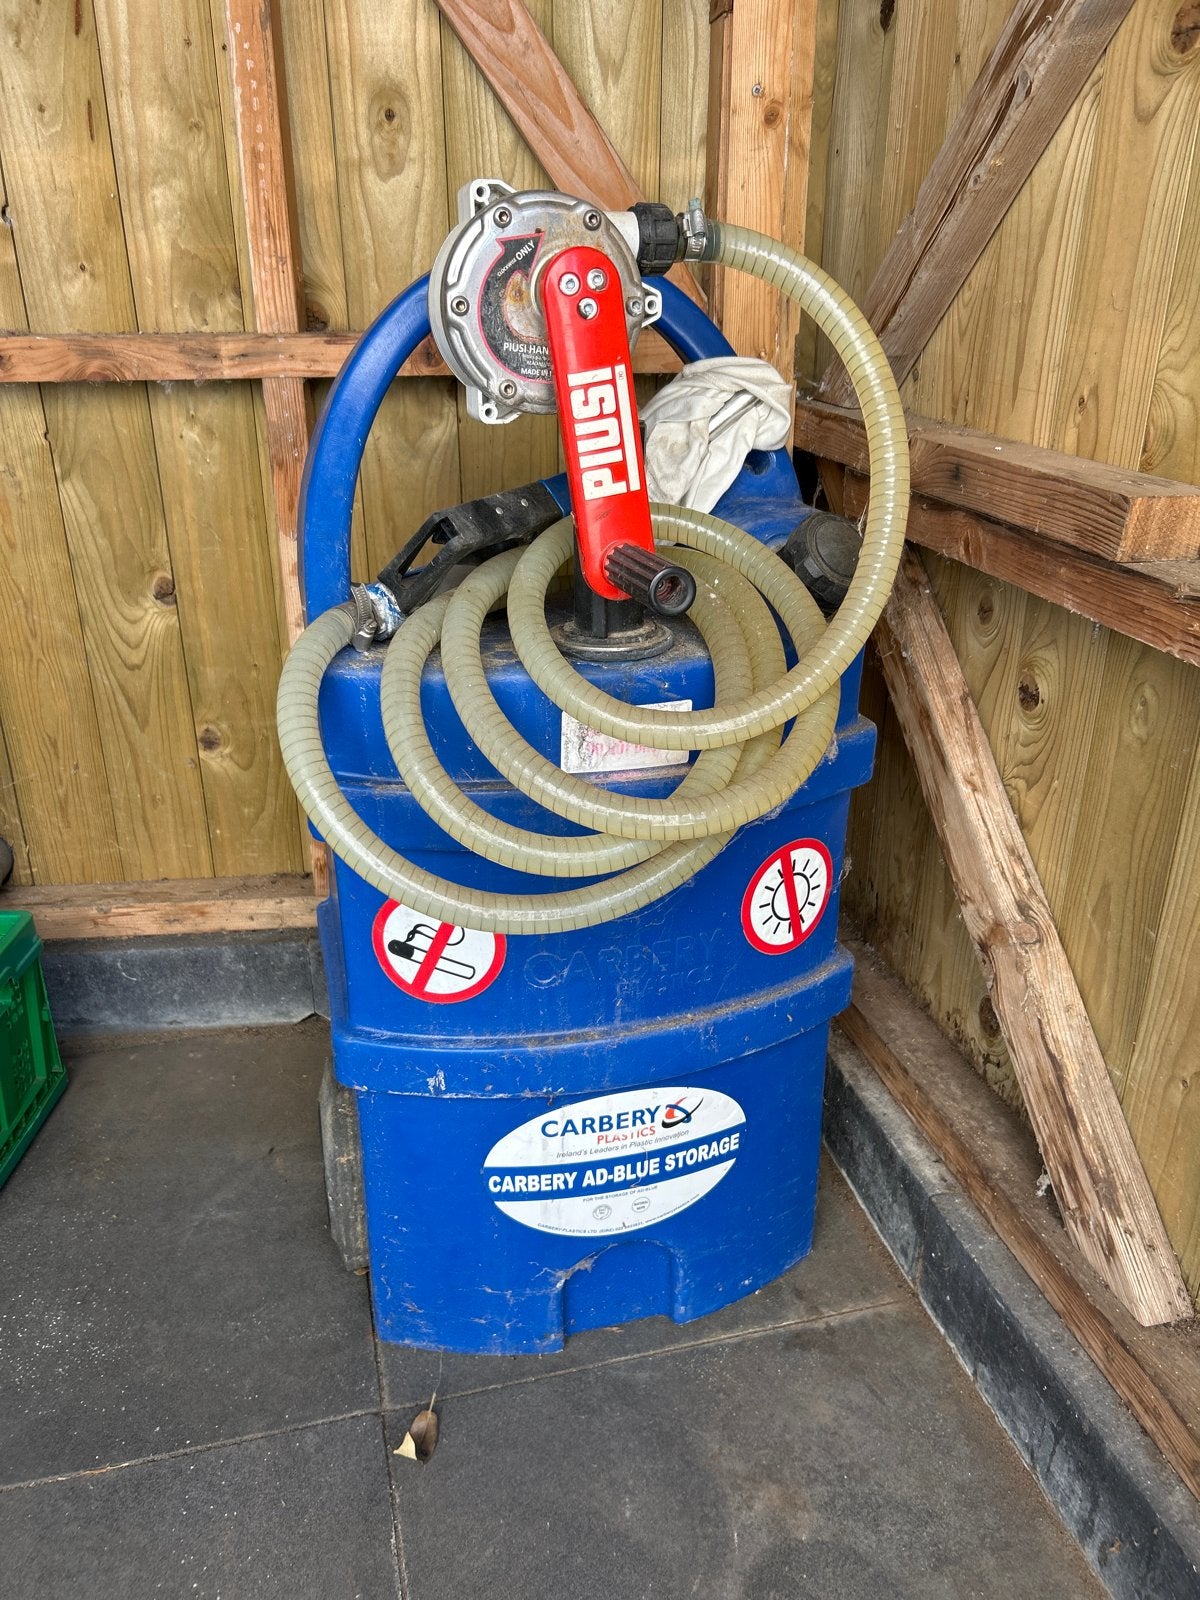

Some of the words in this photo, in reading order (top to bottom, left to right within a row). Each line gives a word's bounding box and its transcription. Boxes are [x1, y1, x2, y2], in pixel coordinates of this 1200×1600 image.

[515, 240, 535, 261] ONLY
[503, 342, 527, 353] PIUSI
[529, 344, 549, 355] HAN
[520, 367, 540, 376] MADE
[567, 366, 628, 501] PIUSI
[541, 1104, 662, 1138] CARBERY
[556, 1148, 588, 1159] Ireland's
[589, 1144, 620, 1155] Leaders
[621, 1142, 628, 1150] in
[629, 1138, 653, 1149] Plastic
[654, 1129, 690, 1144] Innovation
[597, 1126, 656, 1145] PLASTICS
[488, 1171, 578, 1193] CARBERY
[582, 1157, 660, 1188] AD-BLUE
[665, 1132, 740, 1171] STORAGE
[605, 1191, 628, 1200] STORAGE
